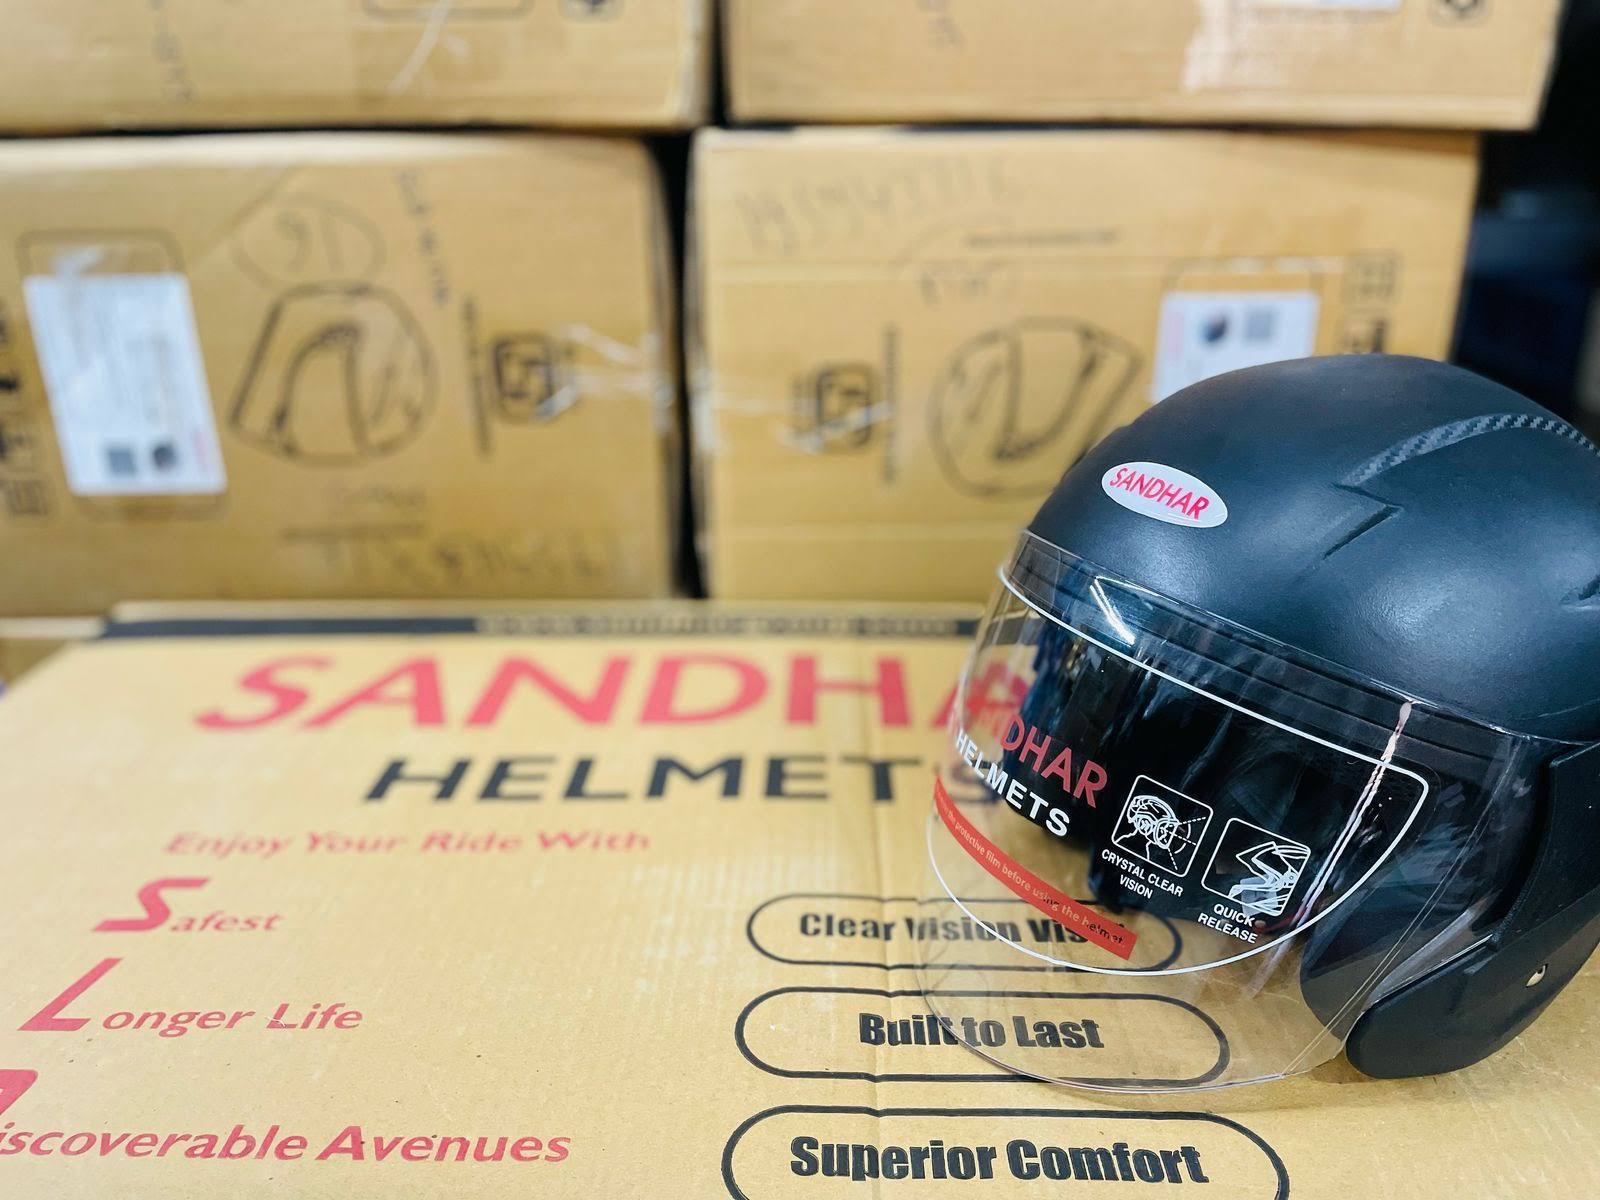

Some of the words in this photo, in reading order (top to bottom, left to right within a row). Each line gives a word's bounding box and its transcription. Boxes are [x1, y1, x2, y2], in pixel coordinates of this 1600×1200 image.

[1109, 467, 1210, 520] SANDHAR
[195, 654, 1030, 730] SANDHA
[956, 728, 1071, 837] HELMETS
[165, 830, 290, 860] Enjoy
[305, 830, 407, 854] Your
[421, 829, 521, 853] Ride
[537, 829, 650, 853] With
[955, 821, 985, 856] protective
[985, 849, 1000, 870] film
[1001, 863, 1031, 891] before
[1032, 886, 1060, 911] using
[1061, 904, 1081, 922] the
[1101, 849, 1146, 880] CRYSTAL
[1147, 873, 1184, 897] CLEAR
[1119, 874, 1154, 899] VISION
[92, 876, 282, 932] Safest
[799, 912, 897, 942] Clear
[905, 914, 1022, 943] Vision
[1197, 912, 1259, 944] RELEASE
[1213, 903, 1256, 927] QUICK
[18, 957, 256, 1038] Longer
[266, 1002, 364, 1031] Life
[859, 1013, 958, 1048] Built
[962, 1016, 1006, 1048] to
[1014, 1015, 1105, 1050] Last
[316, 1125, 572, 1162] Avenues
[790, 1135, 997, 1183] Superior
[1006, 1141, 1209, 1186] Comfort
